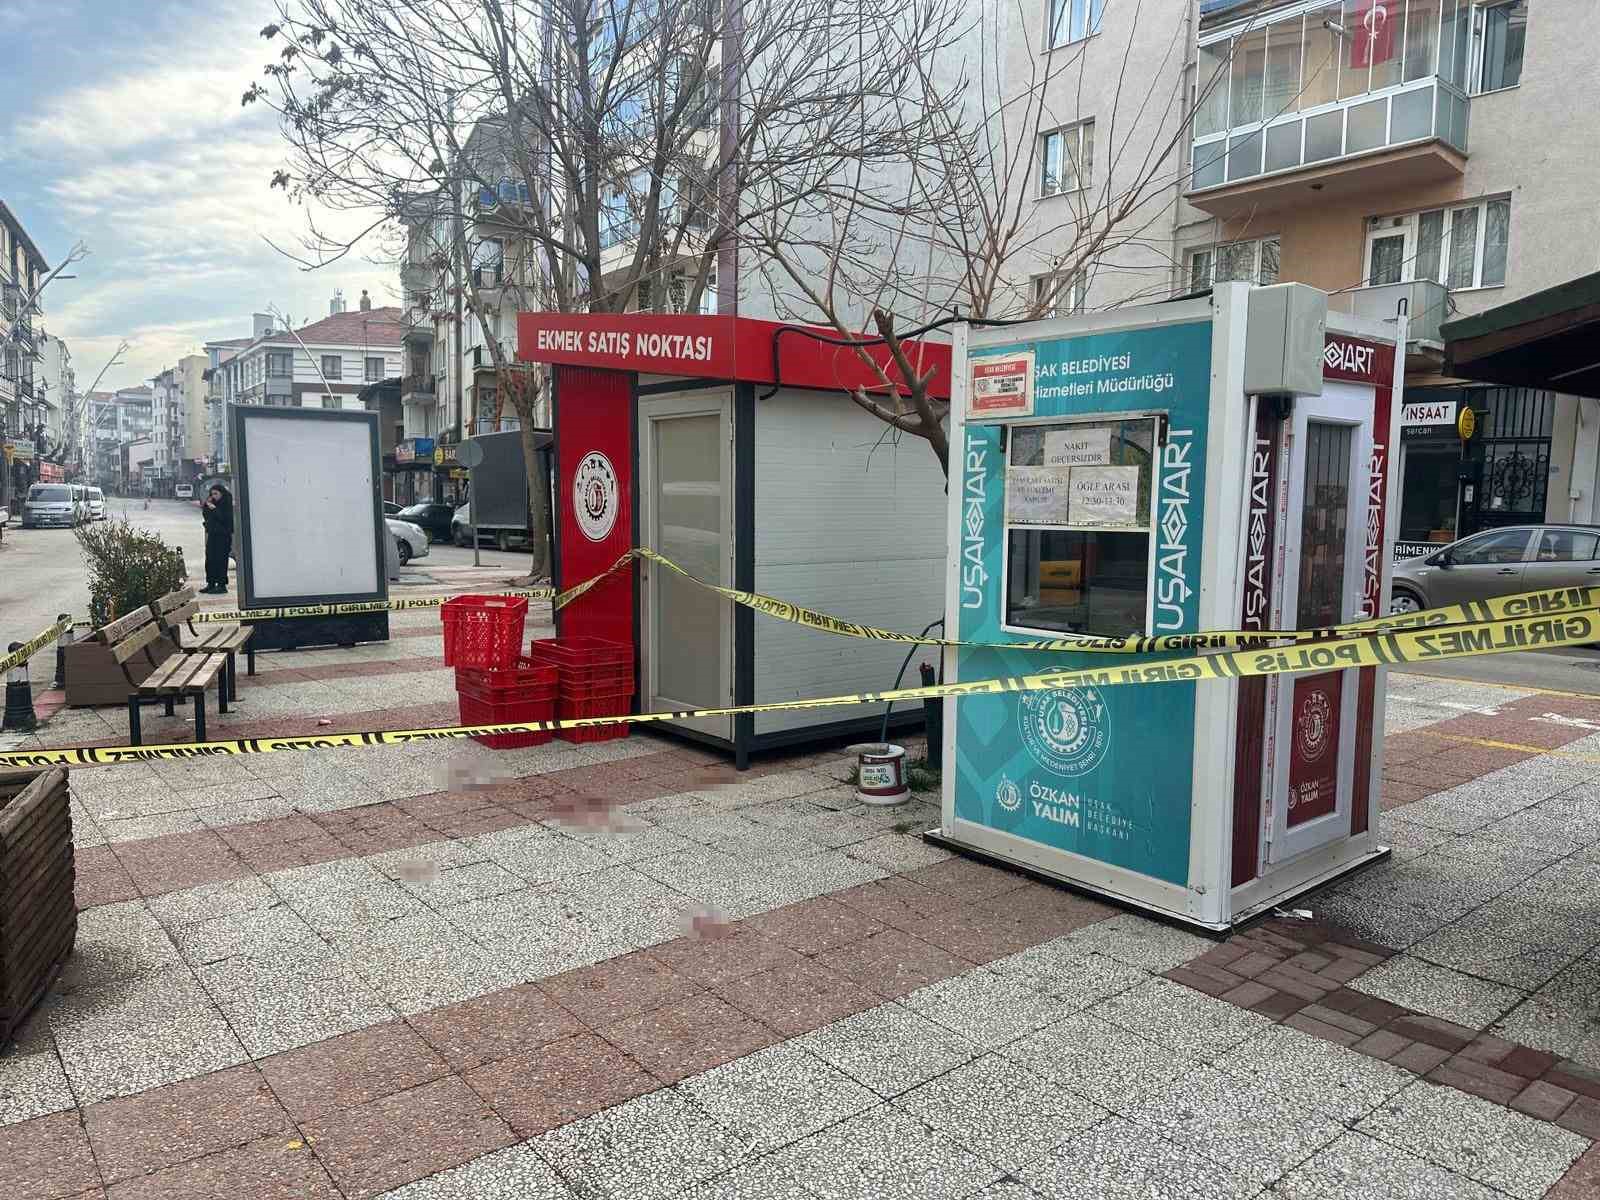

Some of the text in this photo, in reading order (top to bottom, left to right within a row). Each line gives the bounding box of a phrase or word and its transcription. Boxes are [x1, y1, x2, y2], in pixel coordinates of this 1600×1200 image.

[537, 329, 713, 361] EKMEK SATIŞ NOKTASI
[1062, 352, 1131, 376] BELEDİYESİ
[1097, 373, 1174, 393] Müdürlüğü
[1030, 780, 1080, 809] ÖZKAN
[1032, 801, 1080, 828] YALIM
